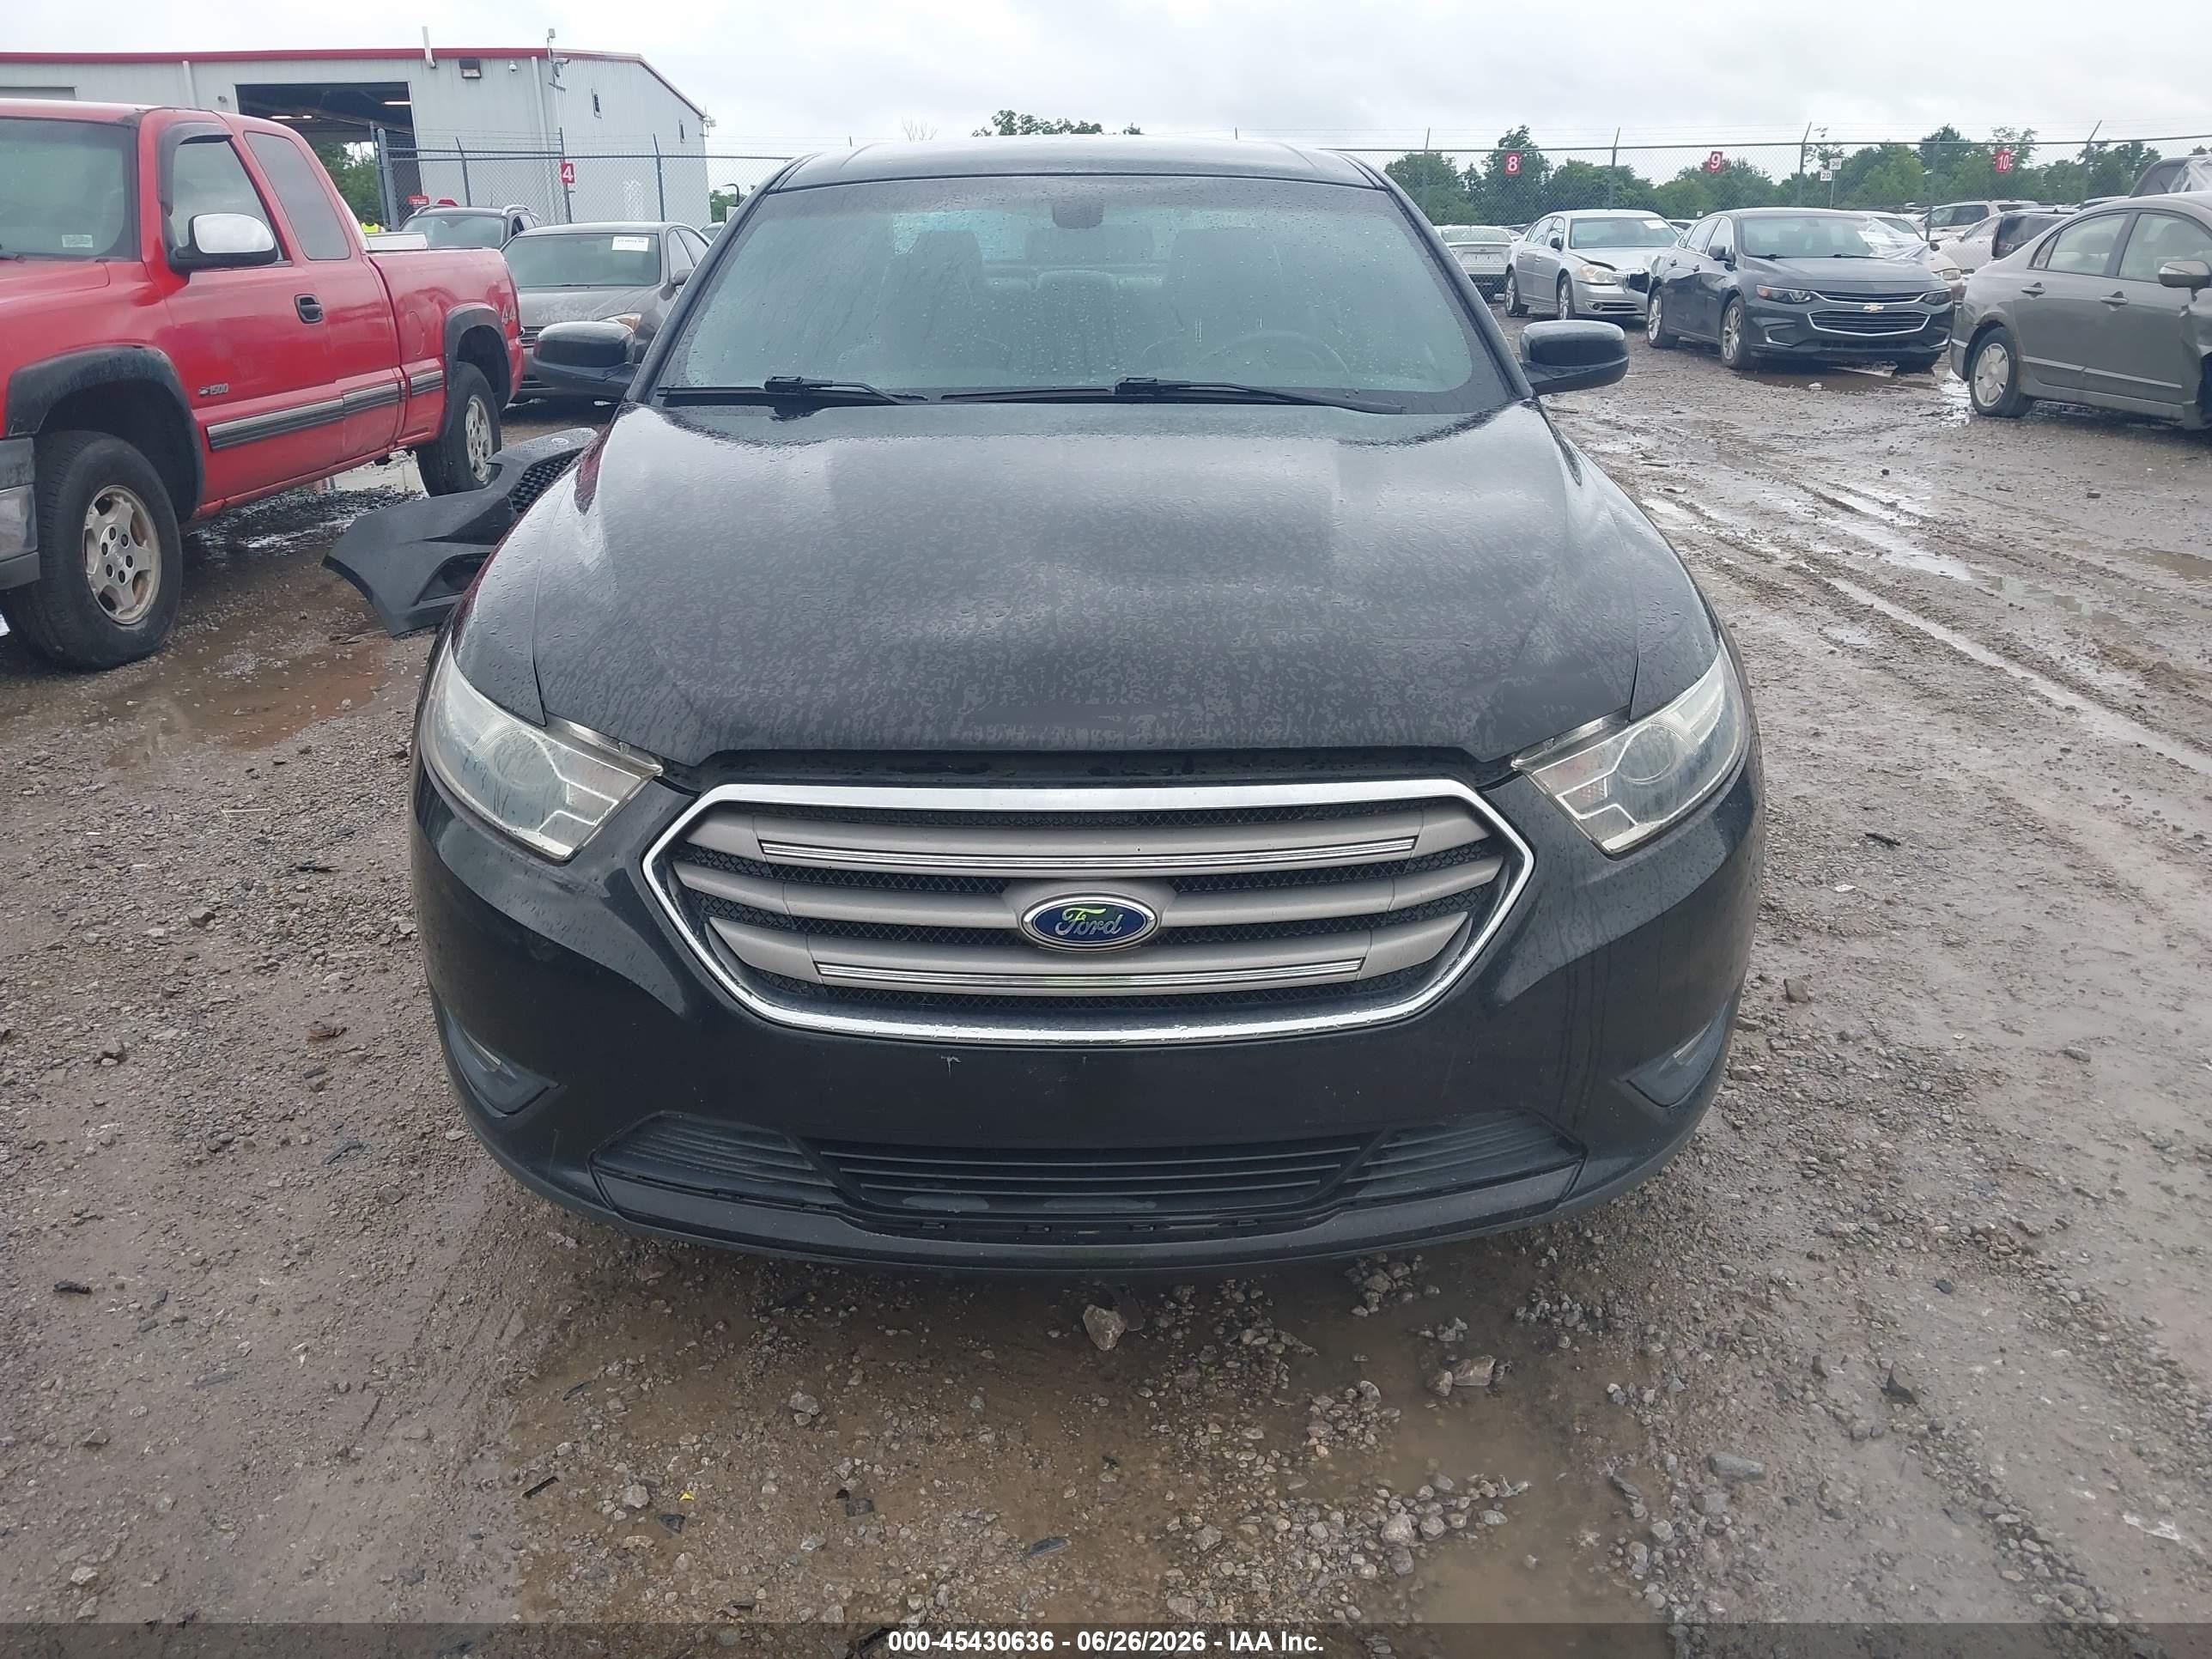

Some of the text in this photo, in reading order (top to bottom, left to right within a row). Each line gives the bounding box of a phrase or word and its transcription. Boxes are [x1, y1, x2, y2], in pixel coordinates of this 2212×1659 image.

[1507, 155, 1518, 172] 8
[1711, 153, 1722, 169] 9
[1998, 155, 2009, 170] 10
[562, 165, 574, 181] 4
[1054, 907, 1125, 937] Ford
